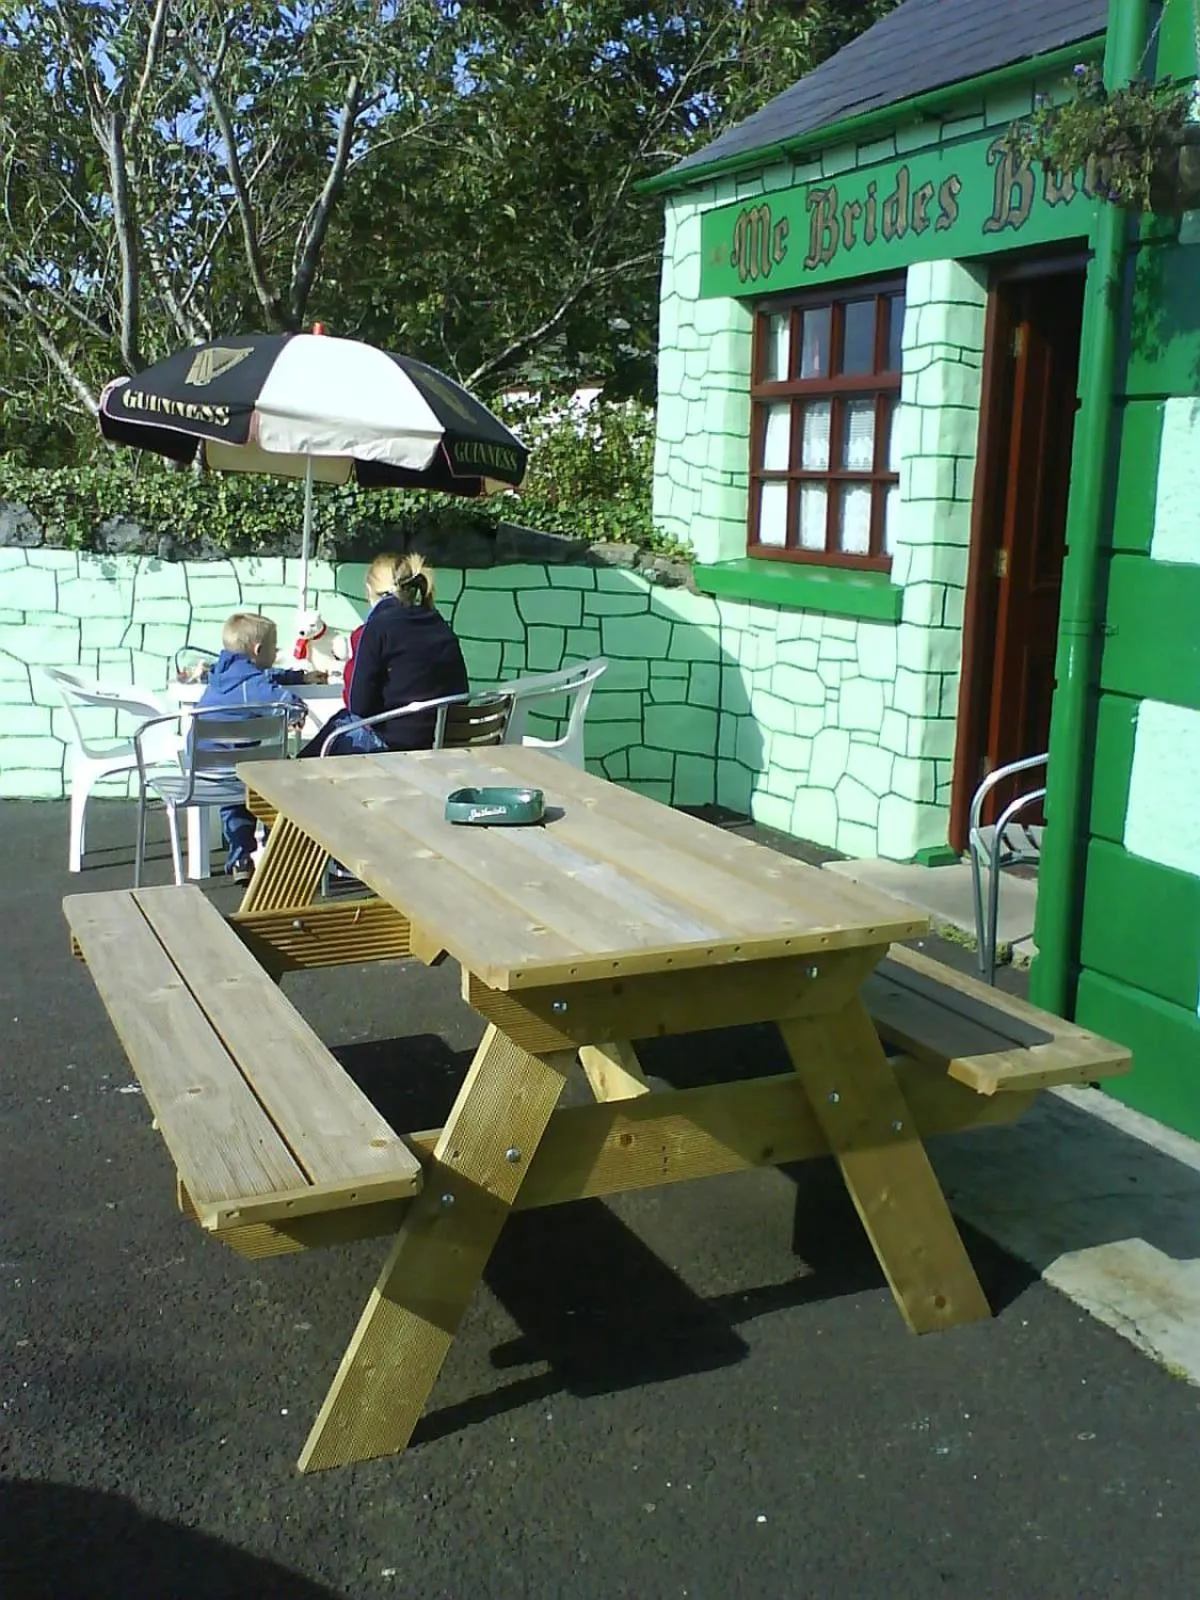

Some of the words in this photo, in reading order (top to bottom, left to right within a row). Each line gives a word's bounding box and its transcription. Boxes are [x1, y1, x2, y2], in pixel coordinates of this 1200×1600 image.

[803, 164, 962, 271] Brides
[122, 388, 231, 427] GUINNESS
[454, 441, 518, 472] GUINNESS
